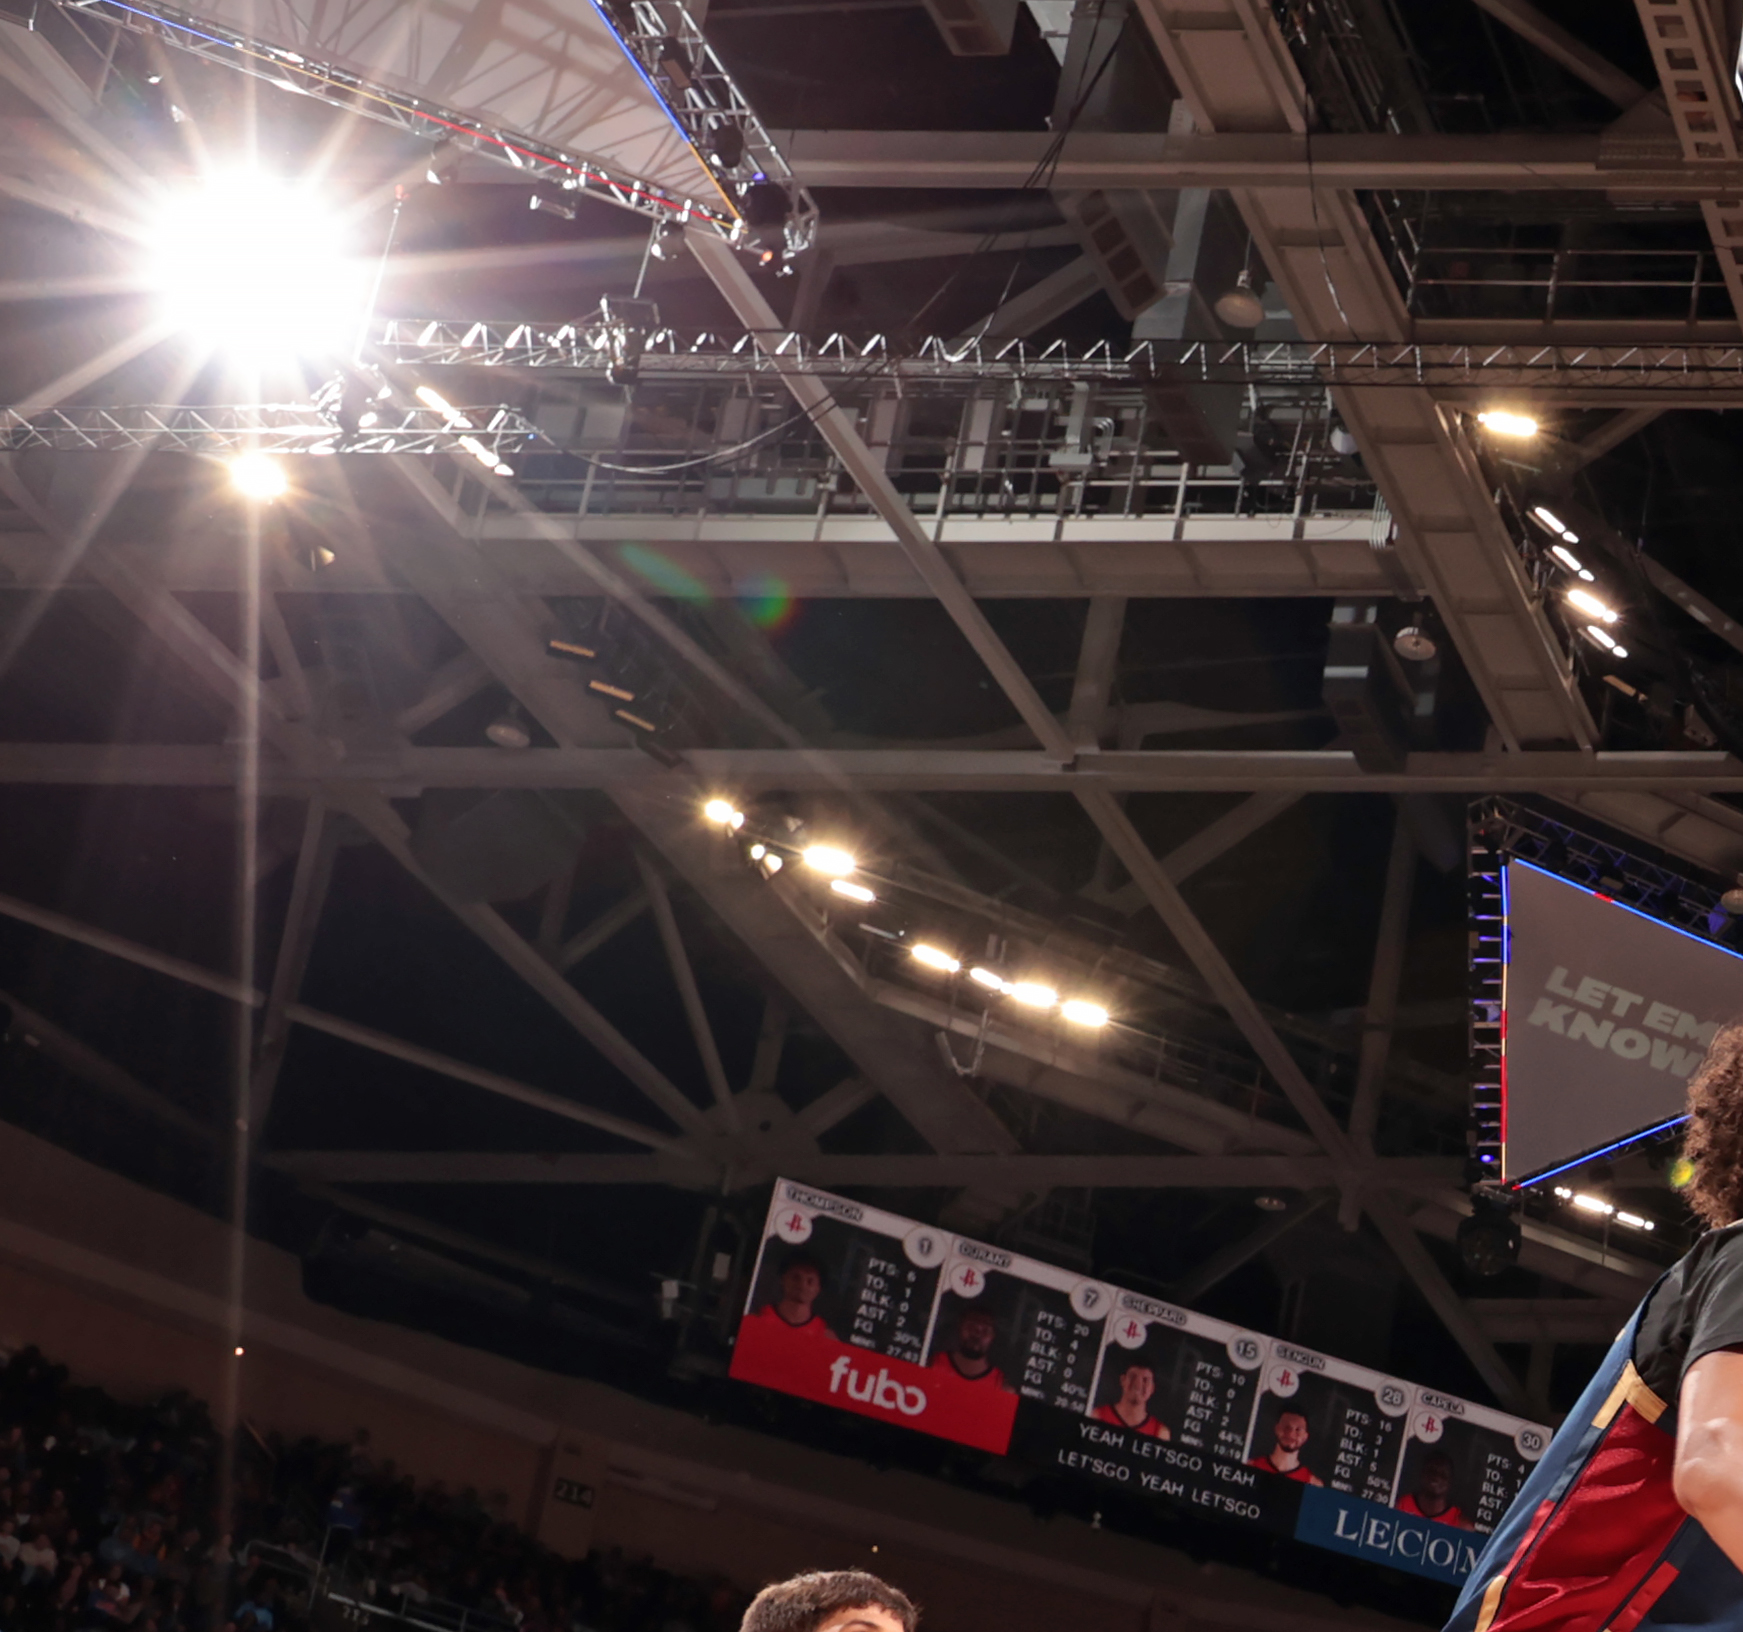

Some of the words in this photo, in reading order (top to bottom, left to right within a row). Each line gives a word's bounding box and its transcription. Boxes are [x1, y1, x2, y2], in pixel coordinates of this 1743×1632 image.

[1545, 965, 1645, 1019] LET
[1527, 997, 1704, 1078] KNOW
[1236, 1343, 1257, 1359] 15
[829, 1355, 927, 1415] fubo
[1382, 1388, 1402, 1405] 28
[1079, 1422, 1125, 1448] YEAH
[1131, 1440, 1202, 1471] LET'SGO
[1211, 1463, 1255, 1486] YEAH
[1522, 1433, 1541, 1450] 30
[1058, 1449, 1130, 1481] LET'SGO
[1140, 1472, 1184, 1497] YEAH
[1191, 1489, 1261, 1519] LET'SGO
